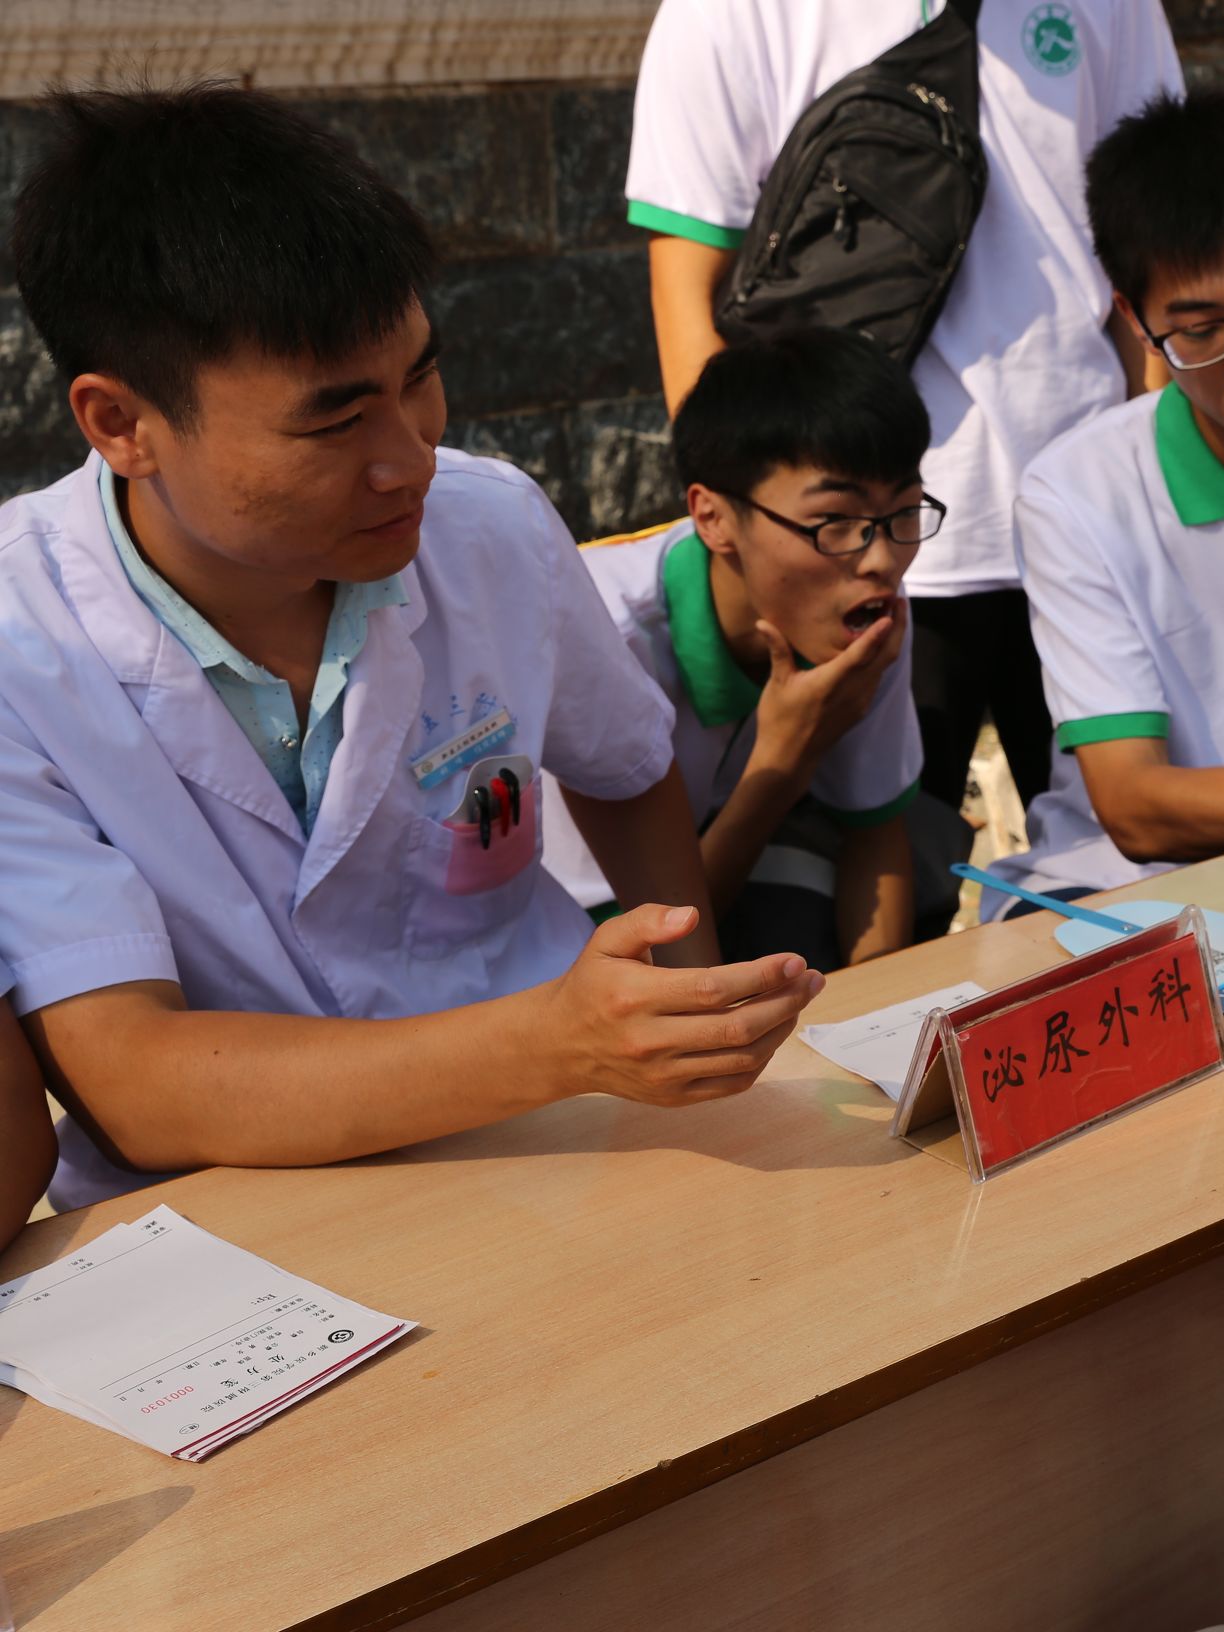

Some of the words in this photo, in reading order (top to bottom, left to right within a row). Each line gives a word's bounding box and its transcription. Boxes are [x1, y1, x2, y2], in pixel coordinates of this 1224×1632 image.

[981, 957, 1192, 1104] 泌尿外科
[140, 1385, 195, 1415] 0001030
